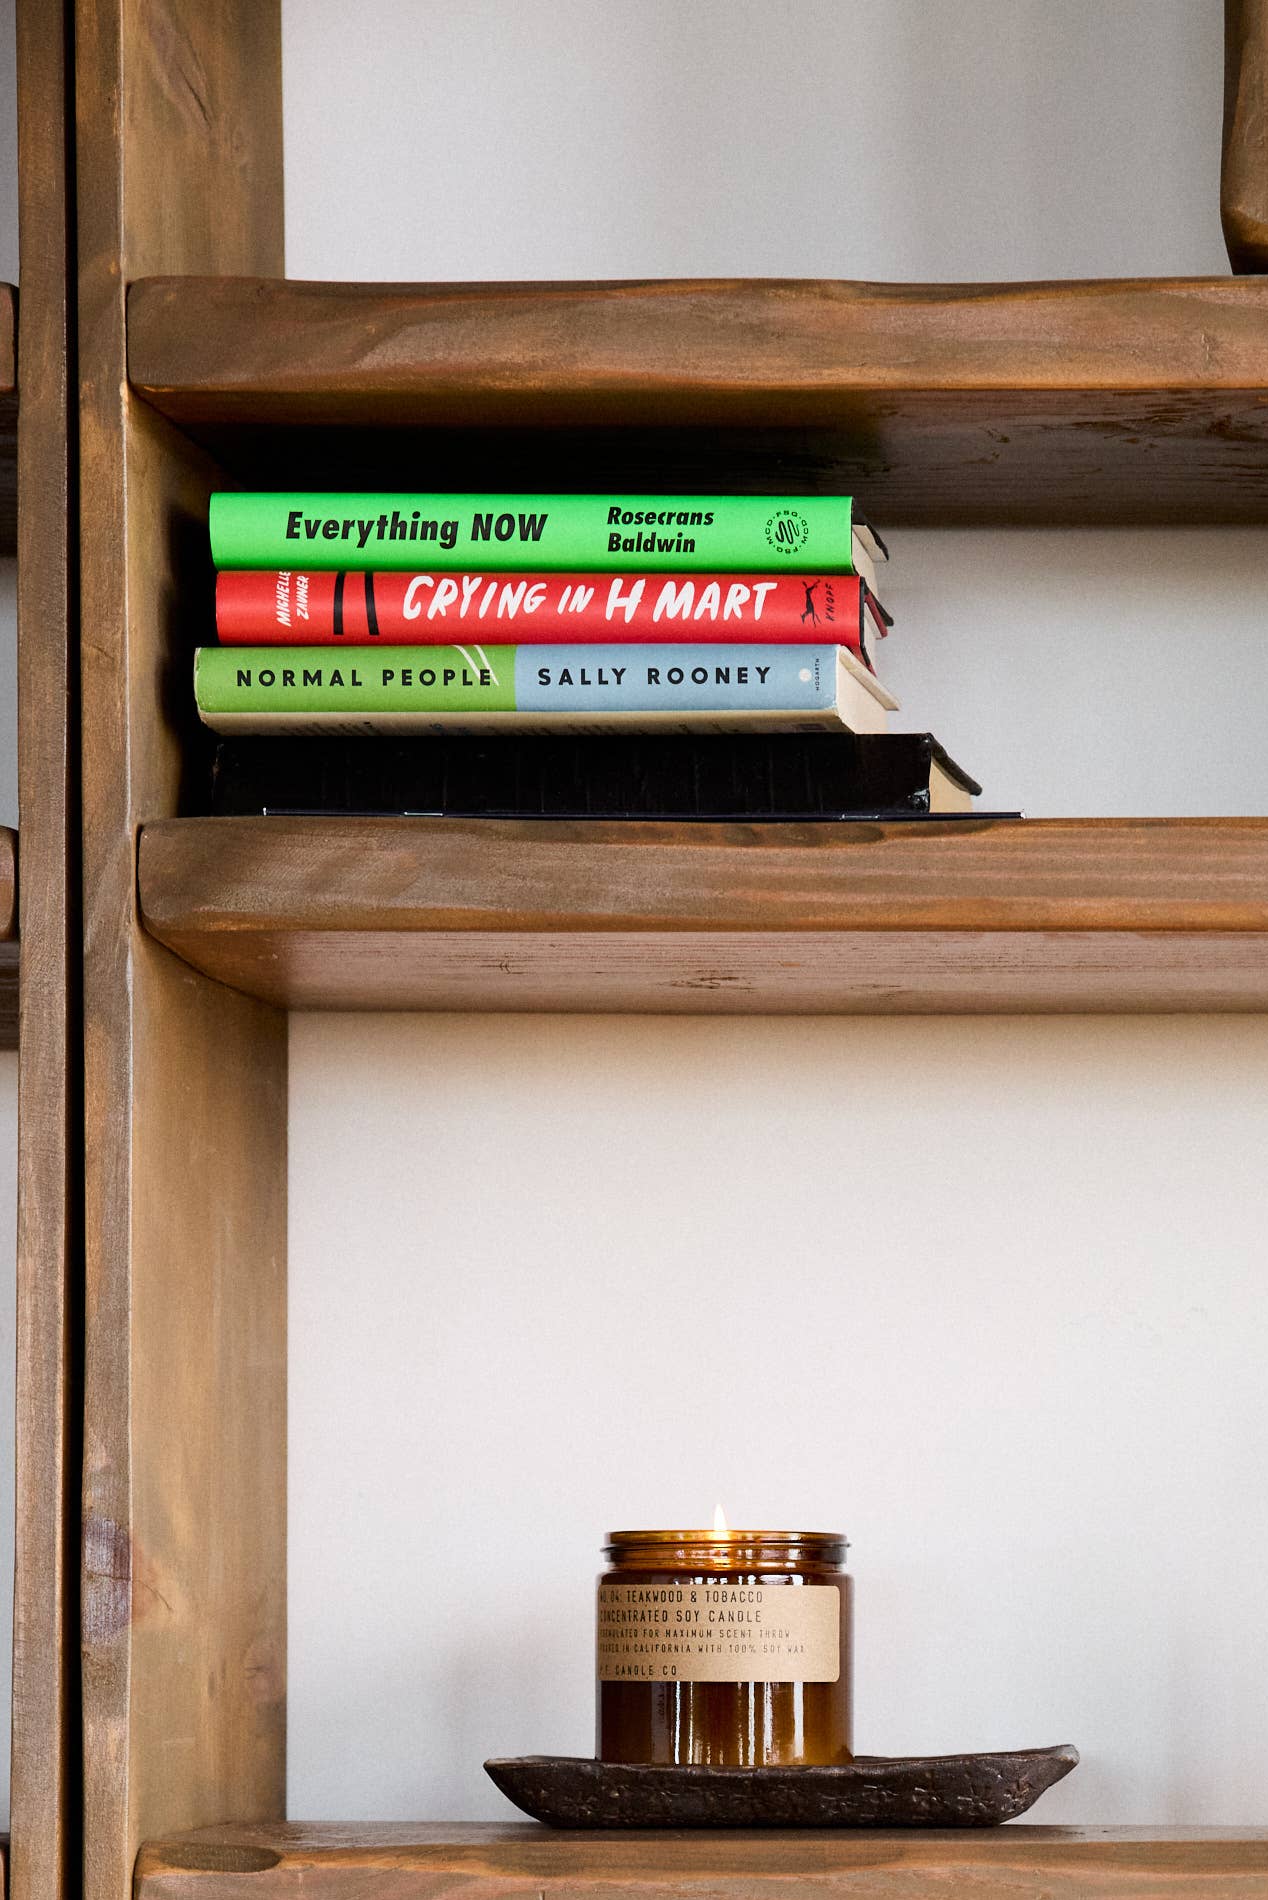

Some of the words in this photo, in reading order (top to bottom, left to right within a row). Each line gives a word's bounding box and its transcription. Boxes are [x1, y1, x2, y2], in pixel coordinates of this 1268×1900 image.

[607, 506, 714, 526] Rosecrans
[286, 511, 459, 549] Everything
[470, 513, 549, 542] NOW
[608, 533, 696, 553] Baldwin
[276, 571, 291, 628] MICHELLE
[296, 575, 310, 621] ZAUNER
[402, 575, 547, 621] CRYING
[557, 584, 595, 615] IN
[605, 577, 646, 624] H
[652, 581, 778, 623] MART
[824, 582, 835, 623] KNOPF
[236, 669, 363, 687] NORMAL
[382, 669, 491, 687] PEOPLE
[537, 667, 627, 686] SALLY
[647, 666, 772, 686] ROONEY
[627, 1590, 683, 1603] TEAKWOOD
[690, 1590, 697, 1603] &
[705, 1590, 763, 1603] TOBACCO
[676, 1610, 700, 1622] SOY
[709, 1610, 761, 1622] CANDLE
[643, 1629, 660, 1638] FOR
[665, 1629, 712, 1638] MAXIMUM
[719, 1629, 752, 1638] SCENT
[634, 1644, 691, 1653] CALIFORNIA
[615, 1665, 654, 1676] CANDLE
